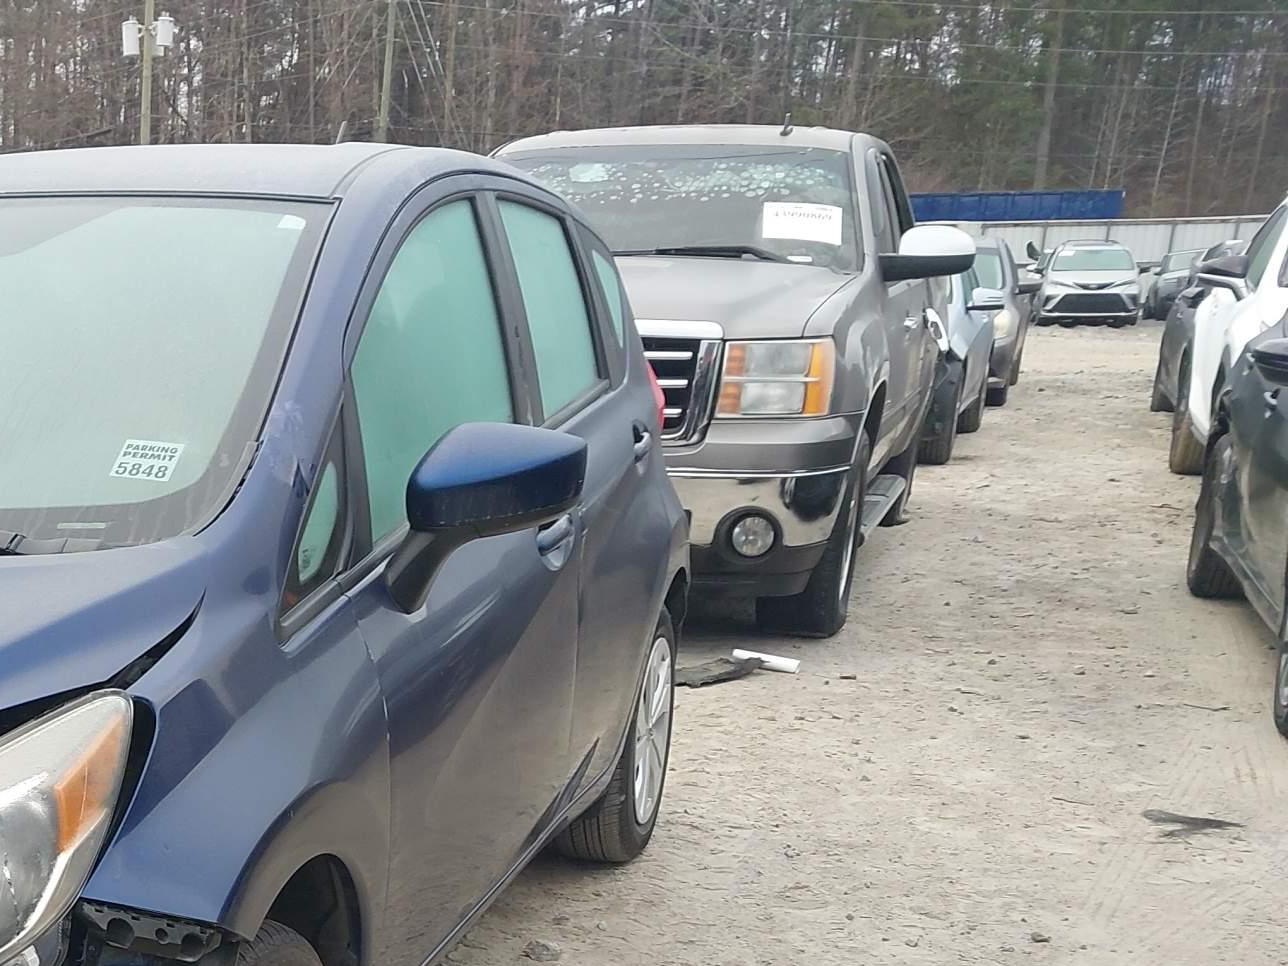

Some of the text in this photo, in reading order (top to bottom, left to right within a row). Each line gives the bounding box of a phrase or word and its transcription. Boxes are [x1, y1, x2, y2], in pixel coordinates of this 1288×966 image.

[125, 443, 178, 454] PARKING
[122, 451, 176, 461] PERMIT
[115, 462, 168, 478] 5848
